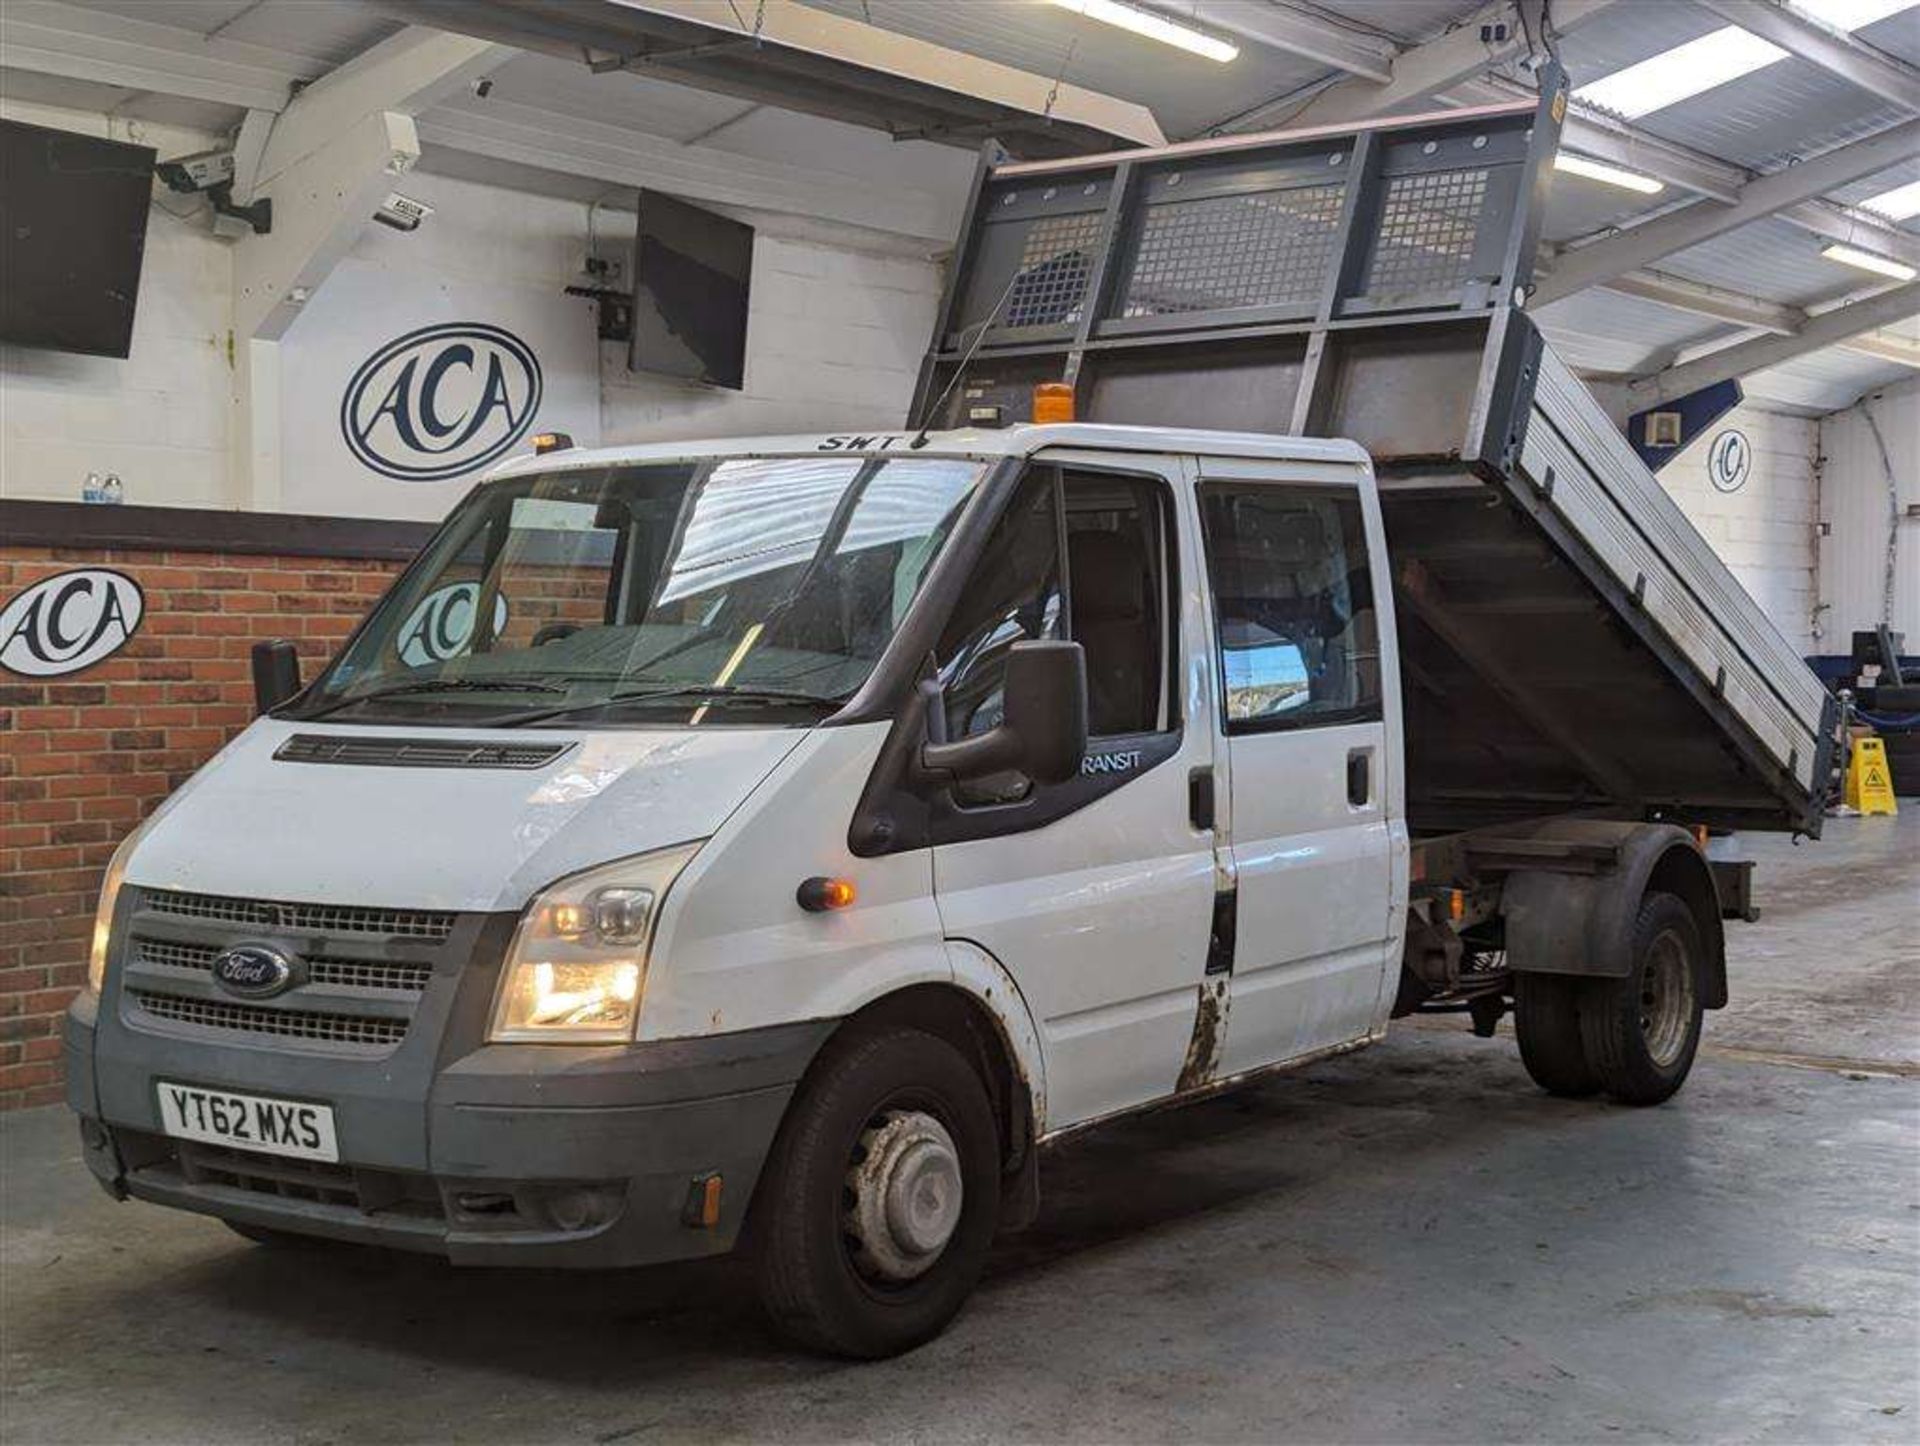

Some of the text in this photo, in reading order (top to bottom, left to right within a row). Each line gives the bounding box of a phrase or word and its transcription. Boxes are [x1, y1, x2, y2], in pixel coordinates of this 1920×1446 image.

[360, 344, 516, 454] ACA
[818, 436, 903, 451] SWT
[0, 578, 129, 663] ACA
[400, 588, 483, 661] AC
[1081, 751, 1141, 775] RANSIT
[223, 954, 267, 982] Ford
[171, 1089, 321, 1149] YT62 MXS
